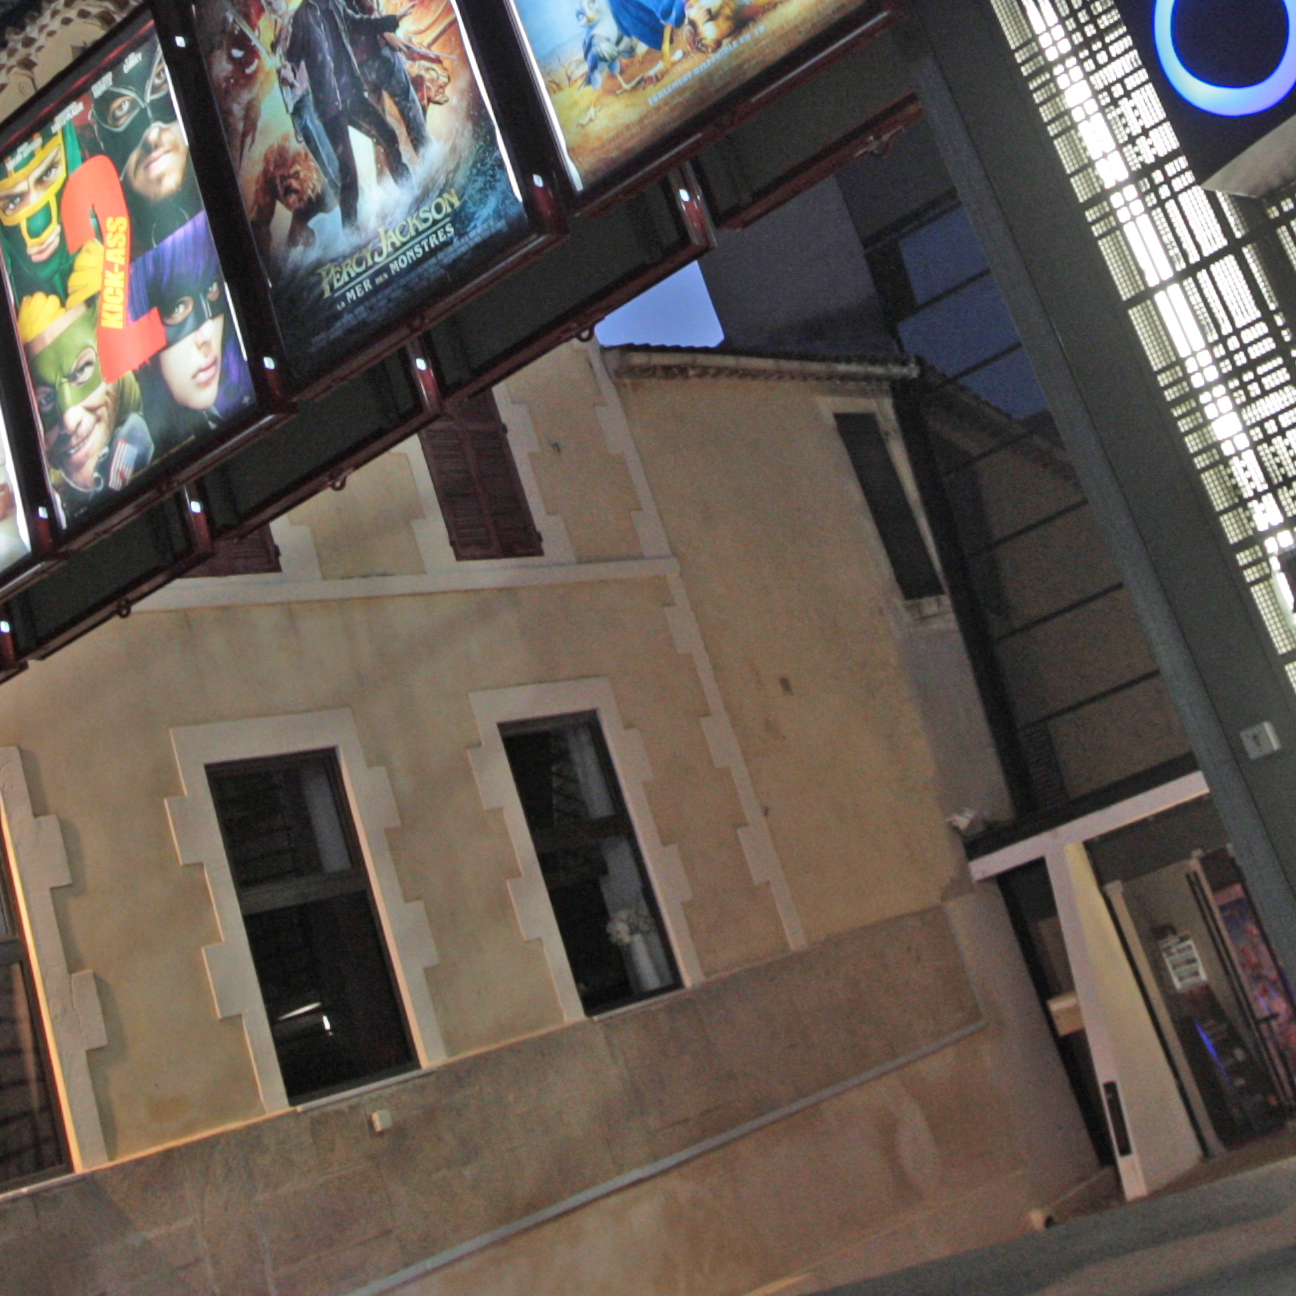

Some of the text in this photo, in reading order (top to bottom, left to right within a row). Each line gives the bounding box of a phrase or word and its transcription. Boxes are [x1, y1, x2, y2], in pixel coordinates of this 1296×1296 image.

[60, 154, 168, 385] 2
[100, 215, 129, 330] KICK-ASS
[315, 187, 461, 300] PERCY JACKSON
[345, 278, 373, 304] MER
[389, 222, 455, 275] MONSTRES
